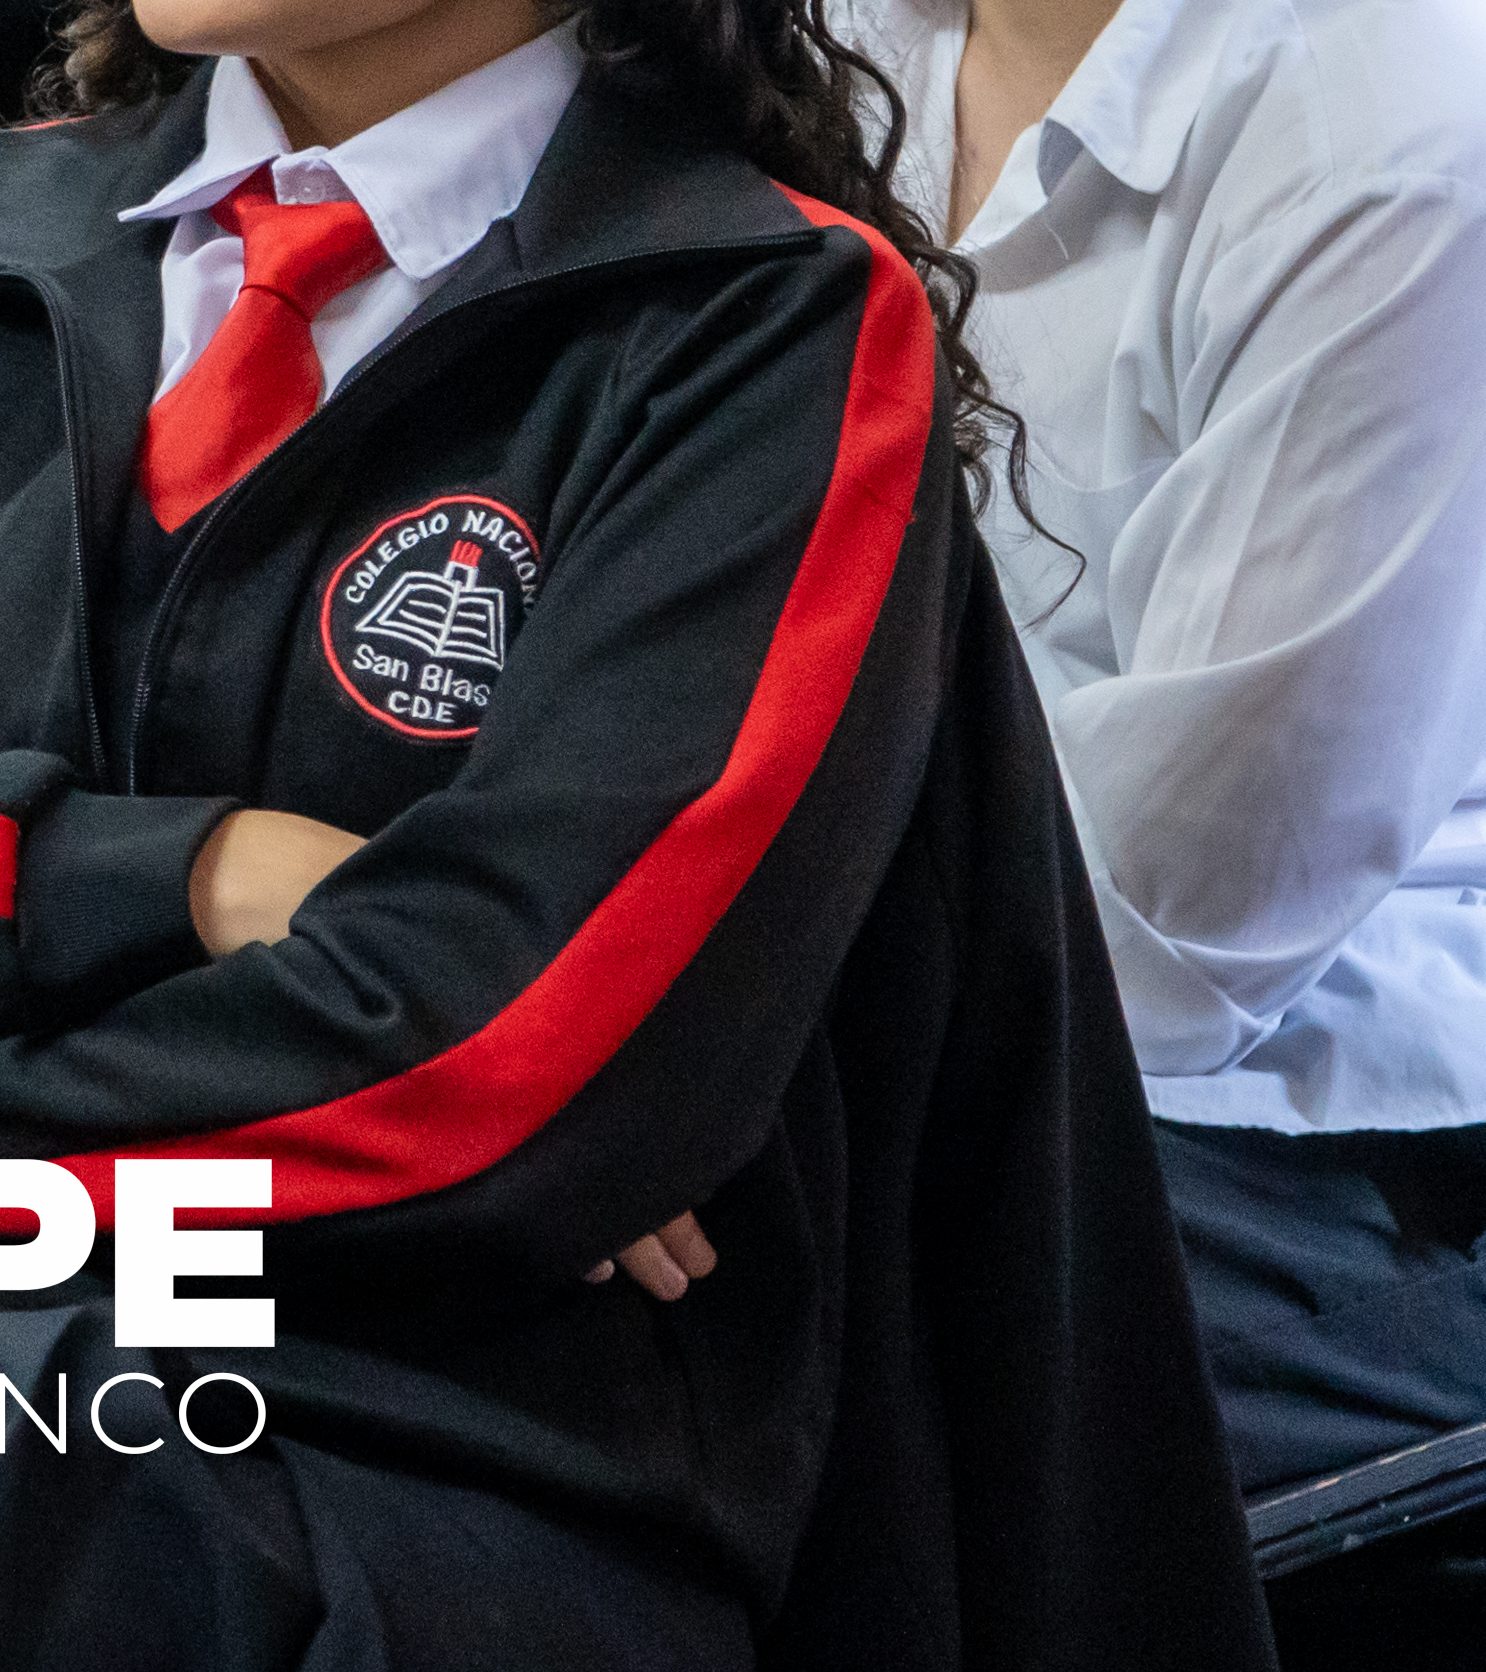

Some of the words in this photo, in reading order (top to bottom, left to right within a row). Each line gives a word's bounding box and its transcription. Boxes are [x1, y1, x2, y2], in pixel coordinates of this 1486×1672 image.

[345, 512, 450, 604] COLEGIO
[352, 643, 410, 682] San
[419, 664, 492, 707] Blas
[387, 690, 456, 724] CDE
